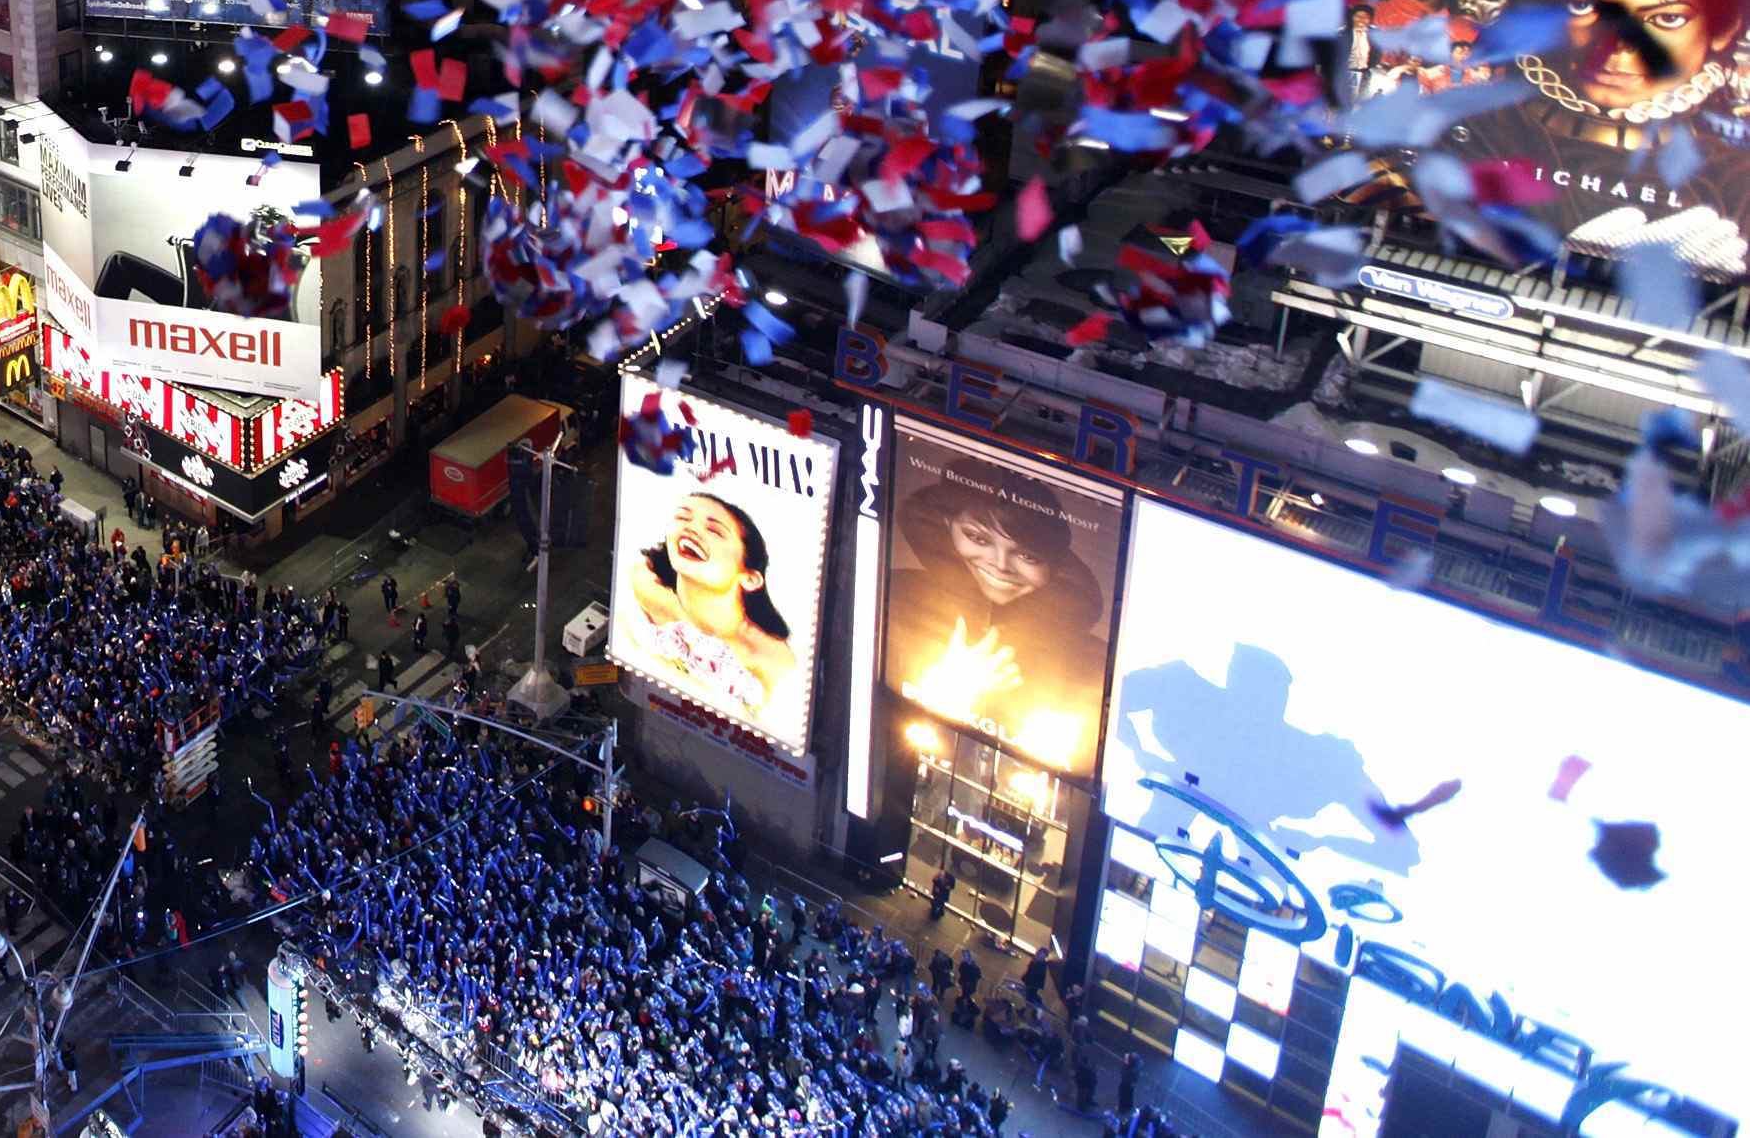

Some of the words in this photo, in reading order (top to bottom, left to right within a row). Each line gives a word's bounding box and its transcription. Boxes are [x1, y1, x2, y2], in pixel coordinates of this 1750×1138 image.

[39, 143, 88, 204] MAXIMUM
[1535, 168, 1684, 209] ICHAEL
[46, 263, 92, 330] maxell
[129, 318, 282, 367] maxell
[748, 442, 814, 498] MIA!
[834, 322, 1750, 682] BERTEL
